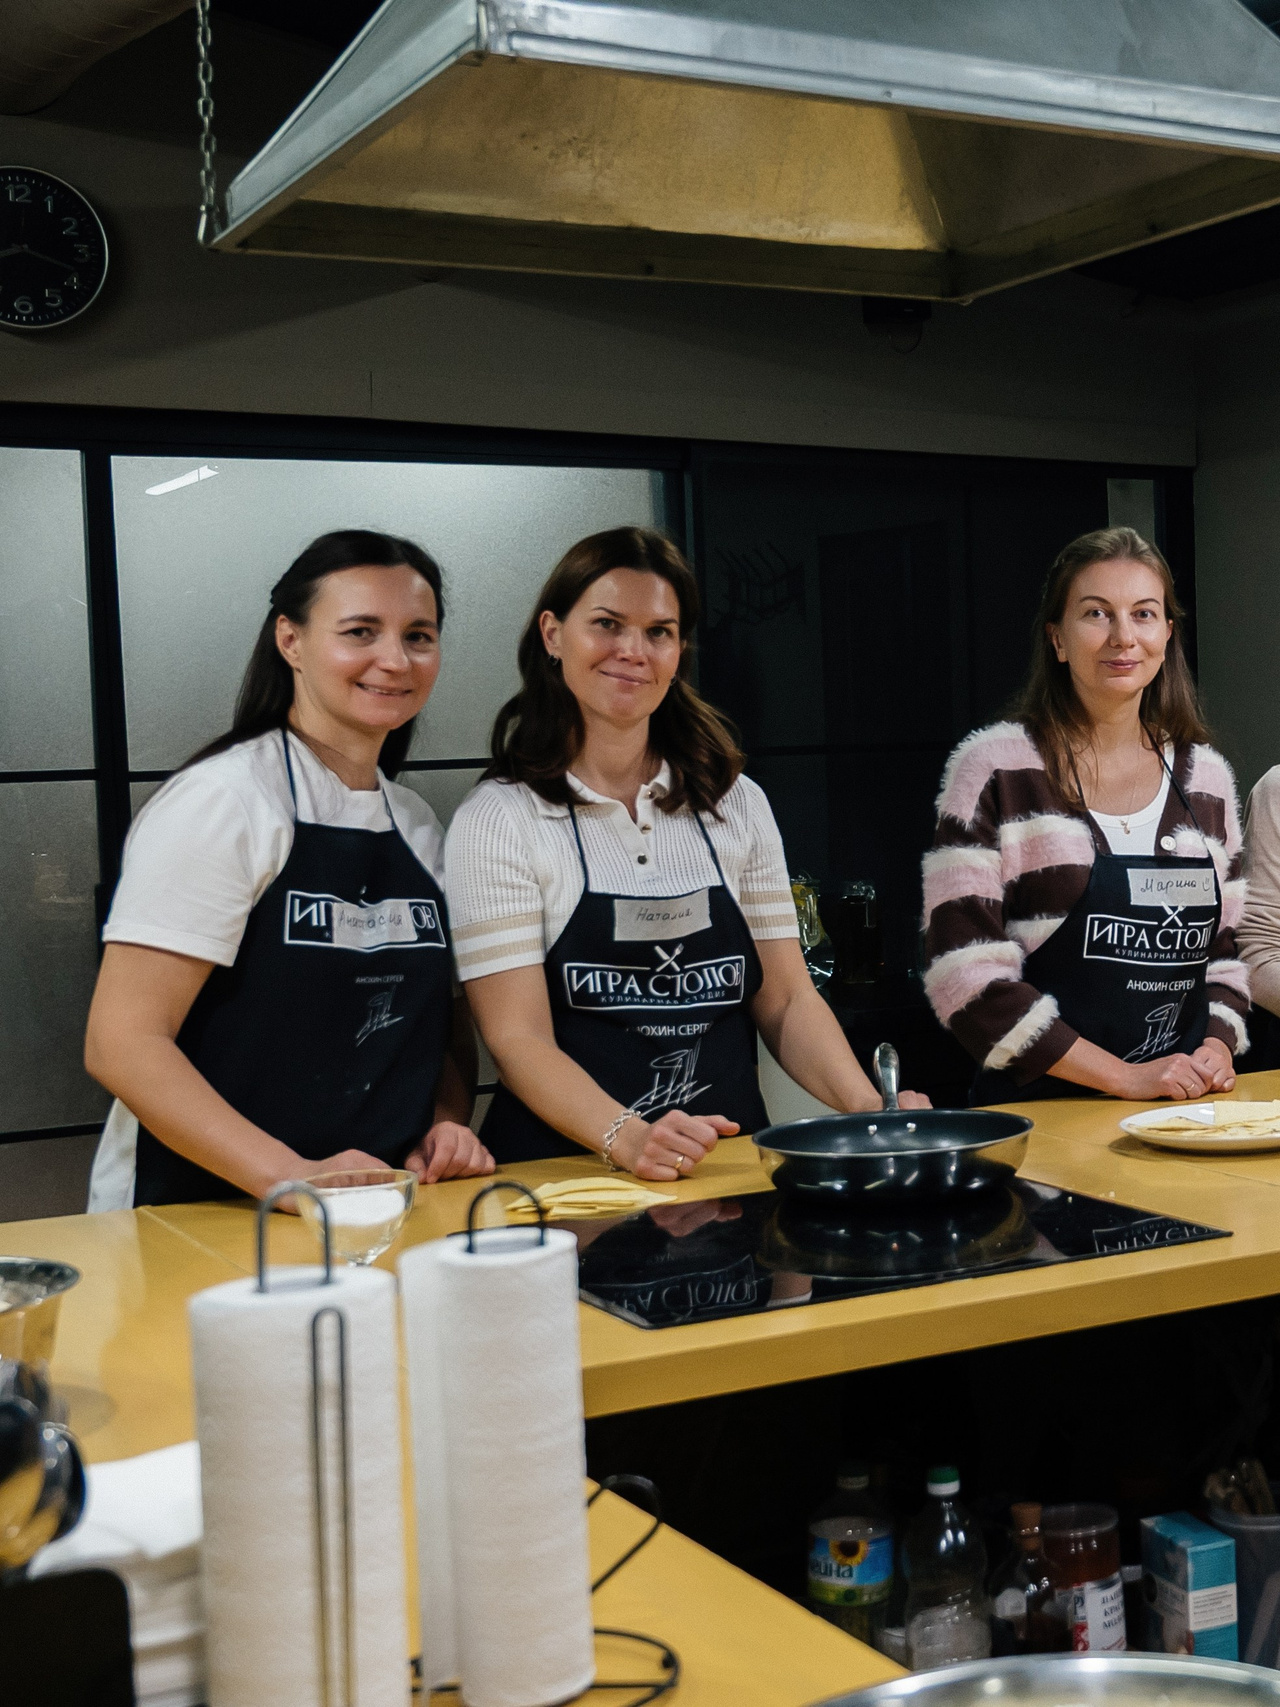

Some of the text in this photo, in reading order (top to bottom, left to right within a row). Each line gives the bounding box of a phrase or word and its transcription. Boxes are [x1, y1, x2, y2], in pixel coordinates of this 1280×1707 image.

[5, 183, 32, 203] 12
[44, 195, 55, 214] 1
[61, 217, 79, 236] 2
[73, 243, 91, 264] 3
[63, 271, 82, 290] 4
[13, 295, 34, 315] 6
[44, 288, 63, 308] 5
[1141, 877, 1197, 895] Марина
[1092, 920, 1212, 950] ИГРА СТОЛ
[1115, 948, 1178, 960] КУЛИНАРНАЯ
[571, 962, 742, 997] ИГРА СТОЛОВ
[1126, 978, 1196, 992] АНОХИН СЕРГЕЙ
[634, 1024, 676, 1036] ОХИН
